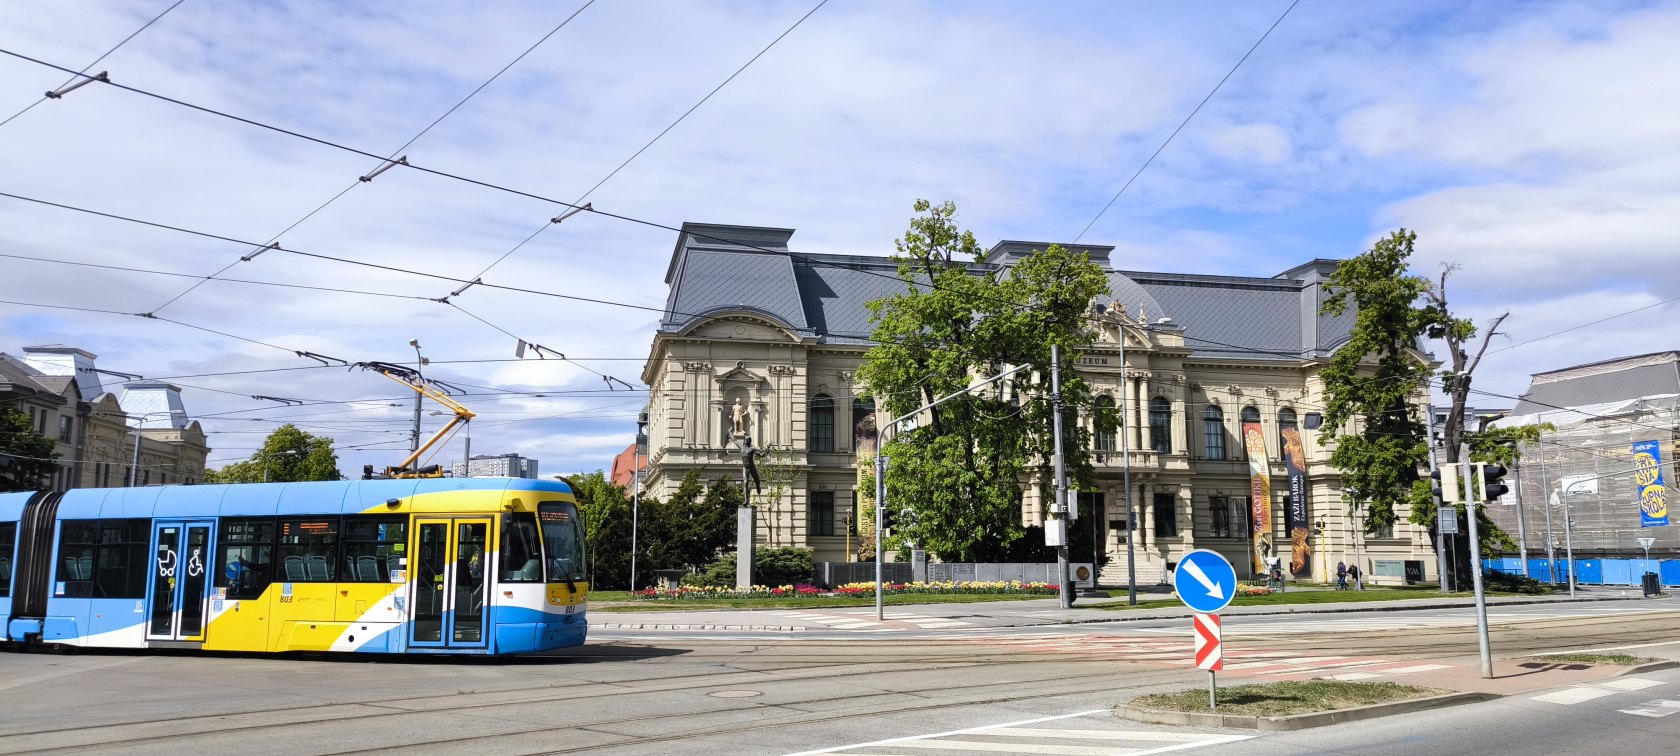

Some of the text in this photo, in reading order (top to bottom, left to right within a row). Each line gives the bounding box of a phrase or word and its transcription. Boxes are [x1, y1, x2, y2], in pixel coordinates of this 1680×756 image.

[1291, 475, 1300, 502] BAROK
[280, 595, 293, 603] 803
[565, 605, 576, 614] 803
